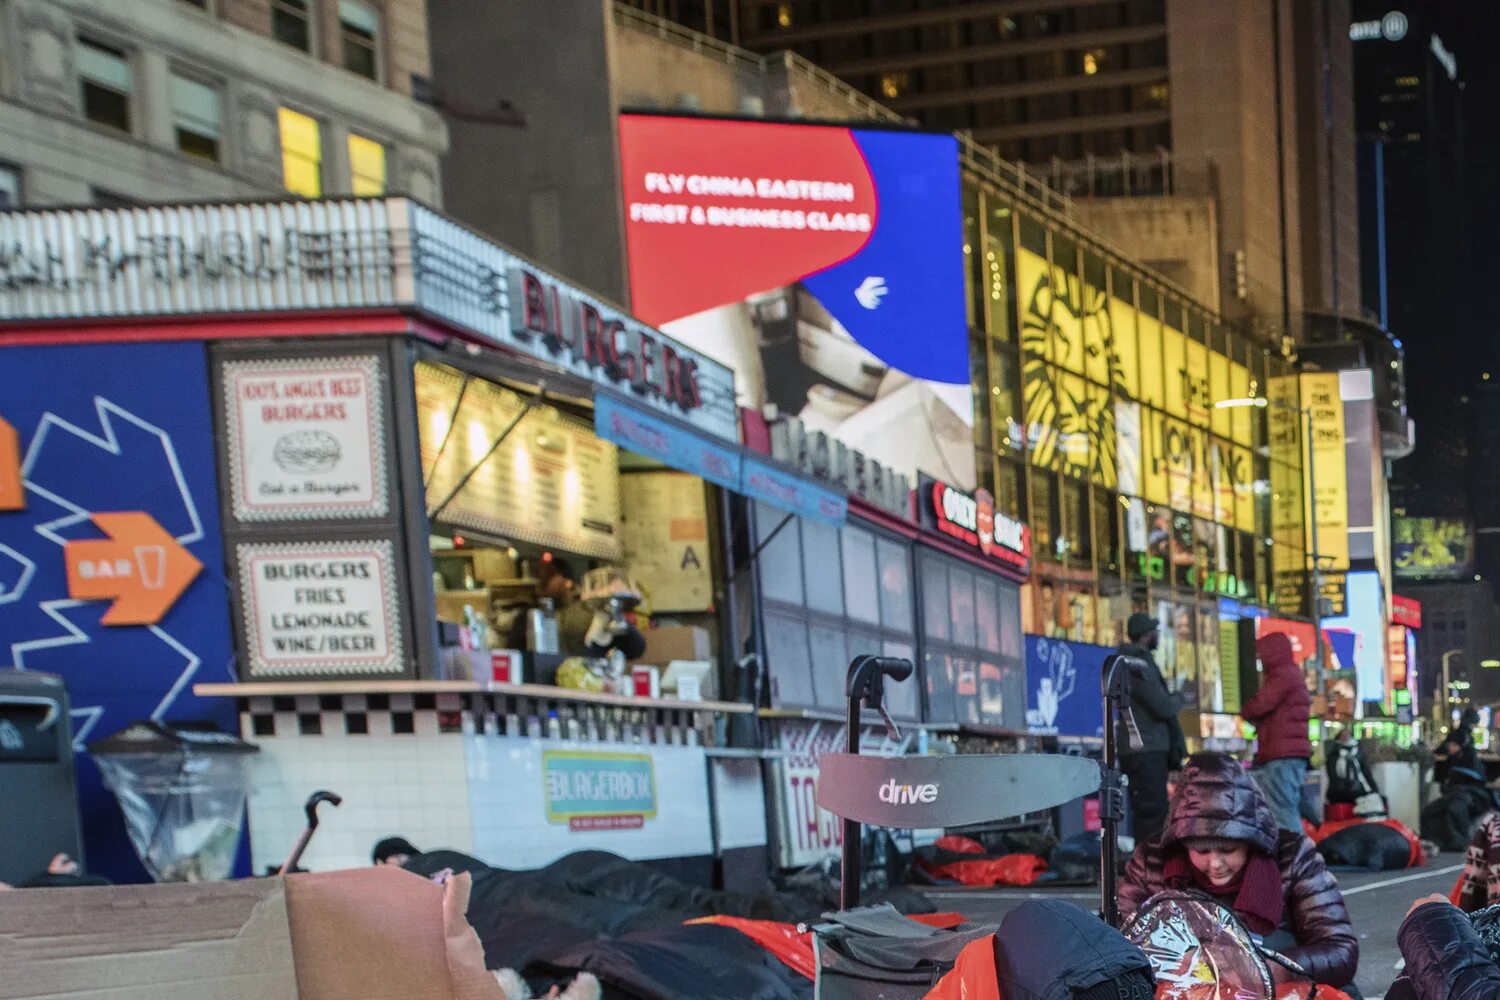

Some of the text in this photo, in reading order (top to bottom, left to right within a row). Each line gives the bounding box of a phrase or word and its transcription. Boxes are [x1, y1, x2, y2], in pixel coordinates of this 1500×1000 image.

[644, 172, 855, 202] FLY CHINA EASTERN
[629, 203, 872, 233] FIRST & BUSINESS CLASS
[261, 403, 346, 423] BURGERS
[680, 546, 701, 570] A
[78, 560, 133, 579] BAR
[263, 561, 370, 582] BURGERS
[294, 587, 345, 604] FRIES
[271, 610, 370, 631] LEMONADE
[271, 636, 376, 653] WINE/BEER
[878, 778, 939, 807] drive
